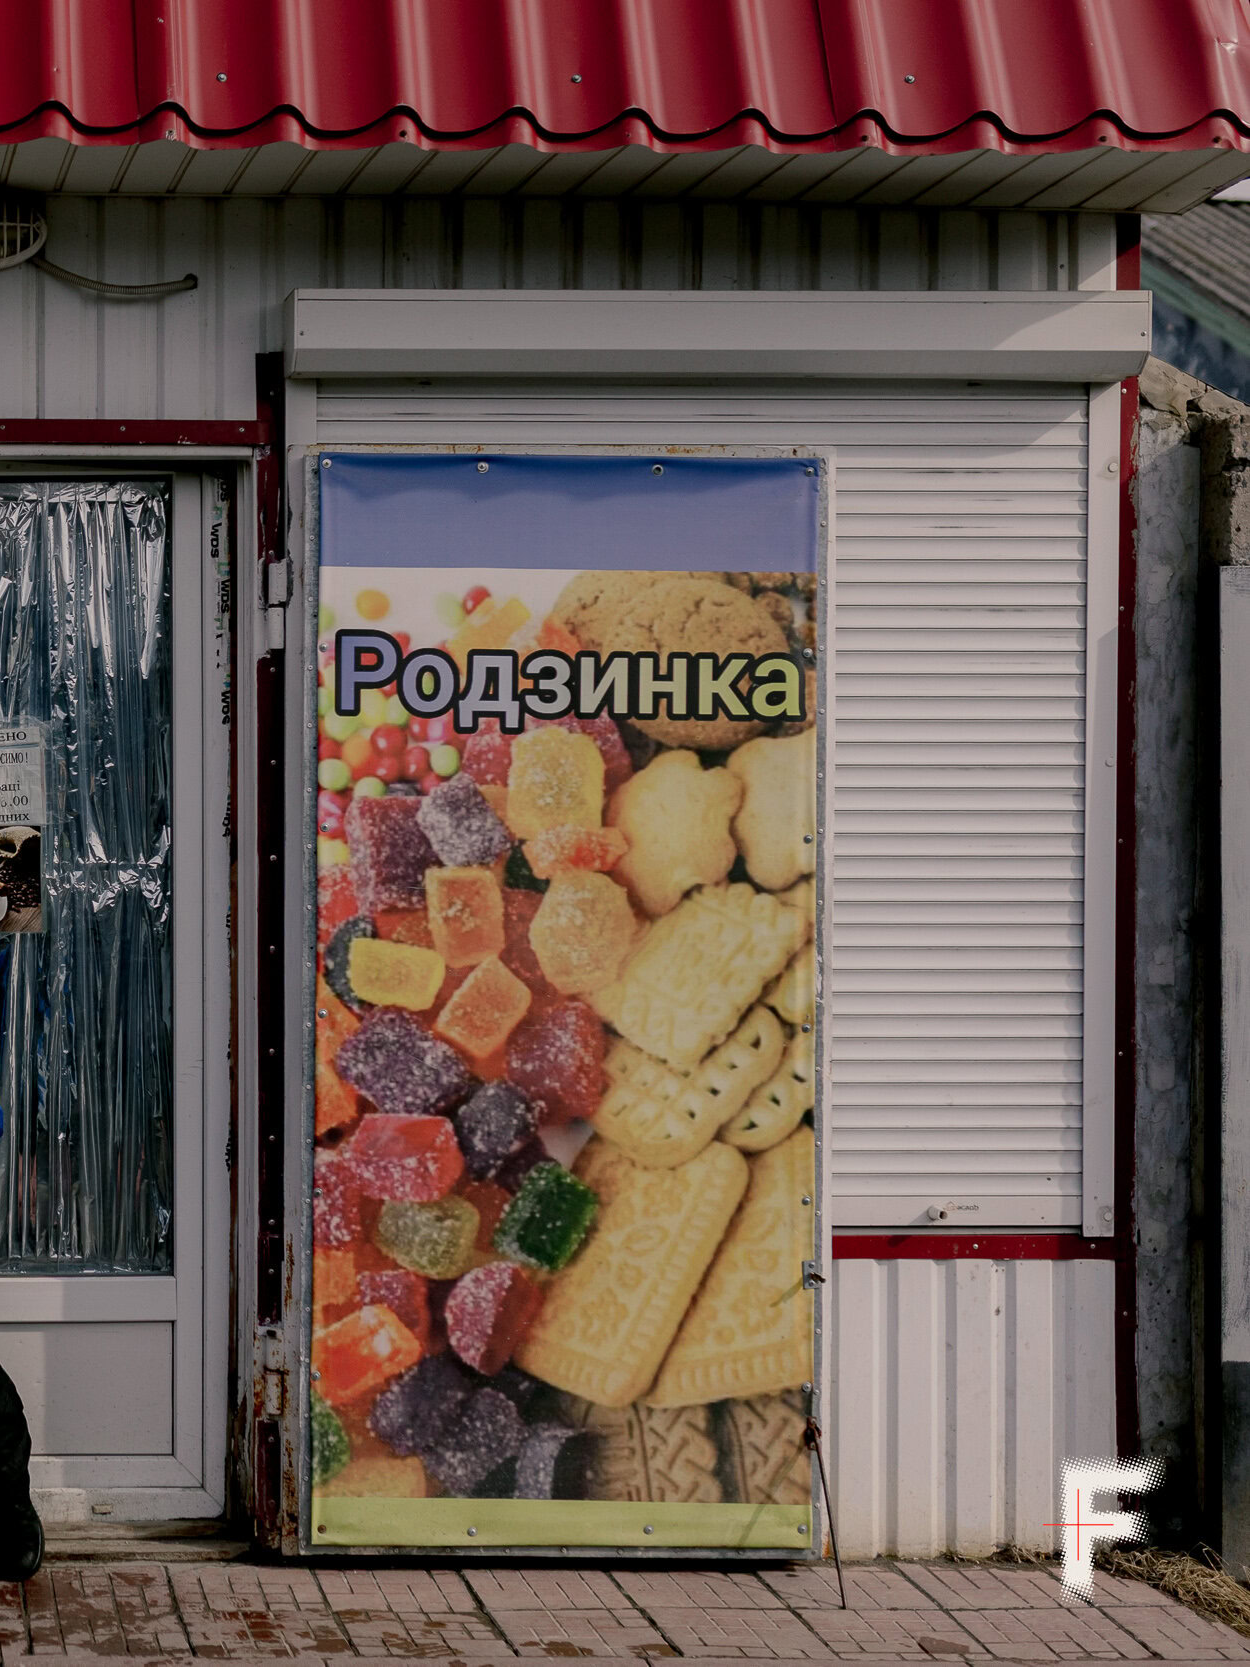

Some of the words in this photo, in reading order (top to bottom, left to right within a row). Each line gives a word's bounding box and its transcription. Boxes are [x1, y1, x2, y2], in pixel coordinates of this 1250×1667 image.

[210, 522, 222, 559] WDS
[220, 580, 230, 614] WDS
[335, 629, 806, 734] Родзинка
